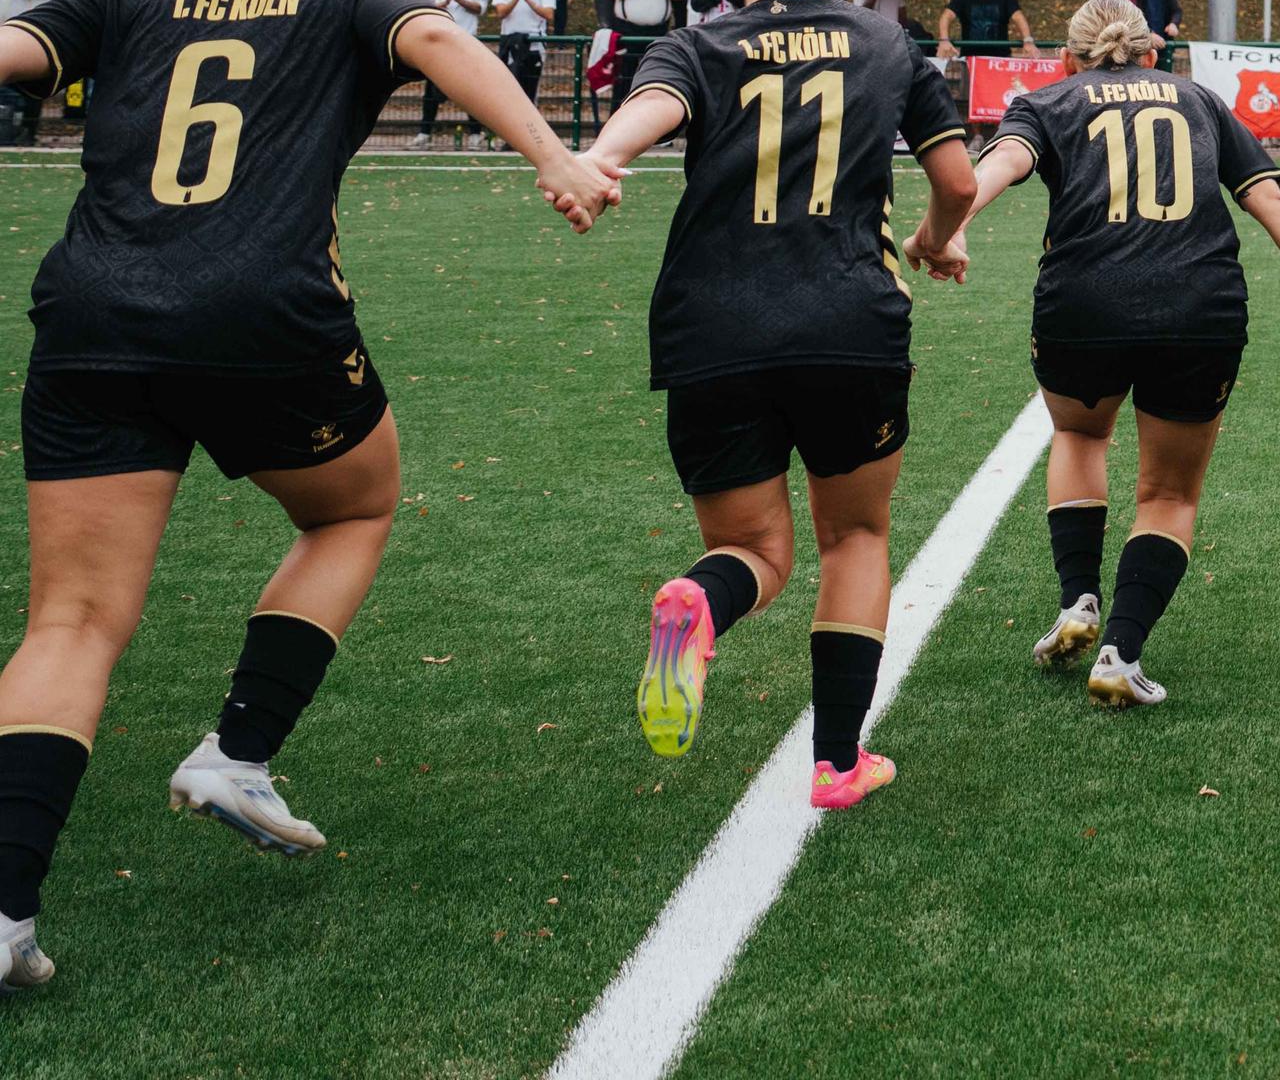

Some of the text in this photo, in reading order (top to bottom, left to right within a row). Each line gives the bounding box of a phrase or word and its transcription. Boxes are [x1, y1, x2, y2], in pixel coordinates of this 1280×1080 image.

[738, 27, 850, 64] 1. FC KÖLN
[1210, 49, 1223, 61] 1.
[1228, 50, 1262, 63] FC
[151, 38, 256, 206] 6
[1084, 80, 1178, 104] 1. FC KÖLN
[740, 70, 844, 224] 11
[1087, 106, 1194, 223] 10
